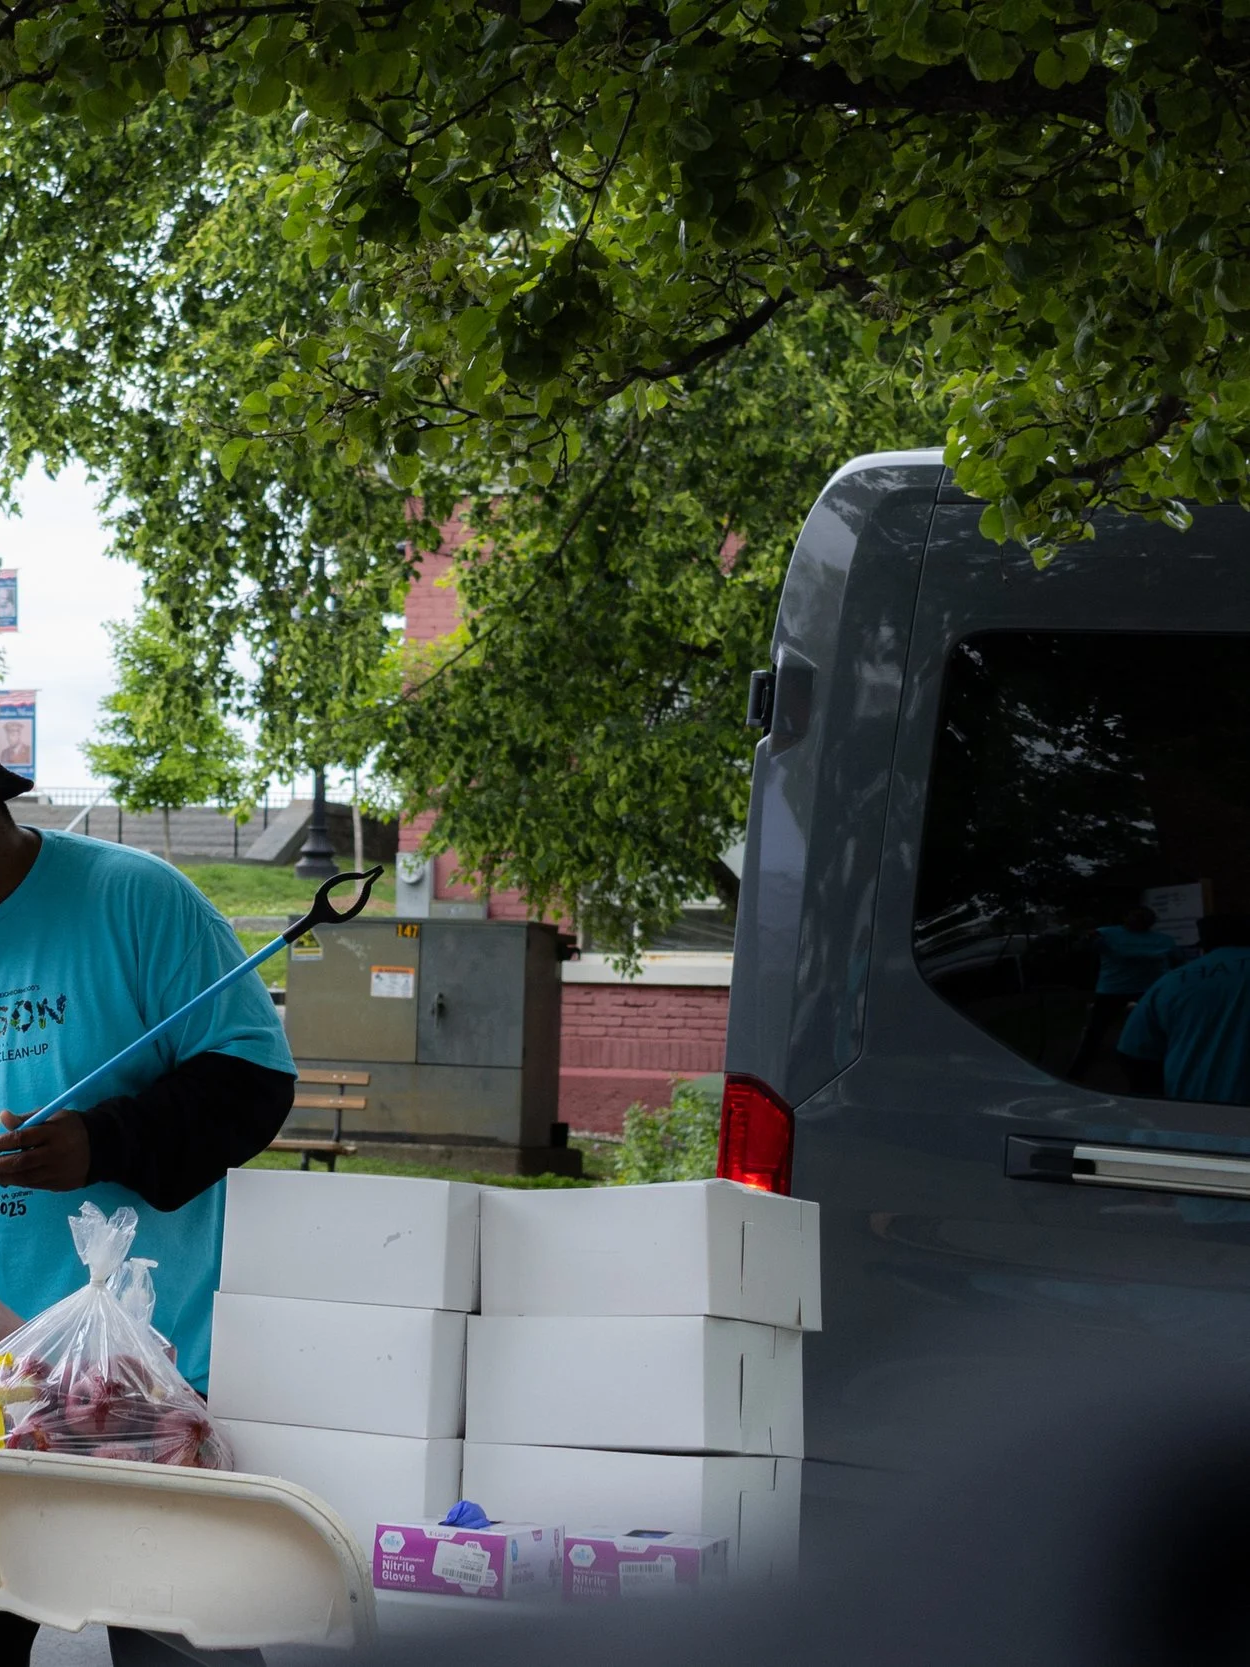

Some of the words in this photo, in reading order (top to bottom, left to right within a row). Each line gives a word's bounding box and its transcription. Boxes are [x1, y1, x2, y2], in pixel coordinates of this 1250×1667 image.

[397, 923, 419, 938] 147
[382, 1560, 415, 1573] Nitrile
[381, 1571, 416, 1583] Gloves
[572, 1574, 607, 1588] Nitrile
